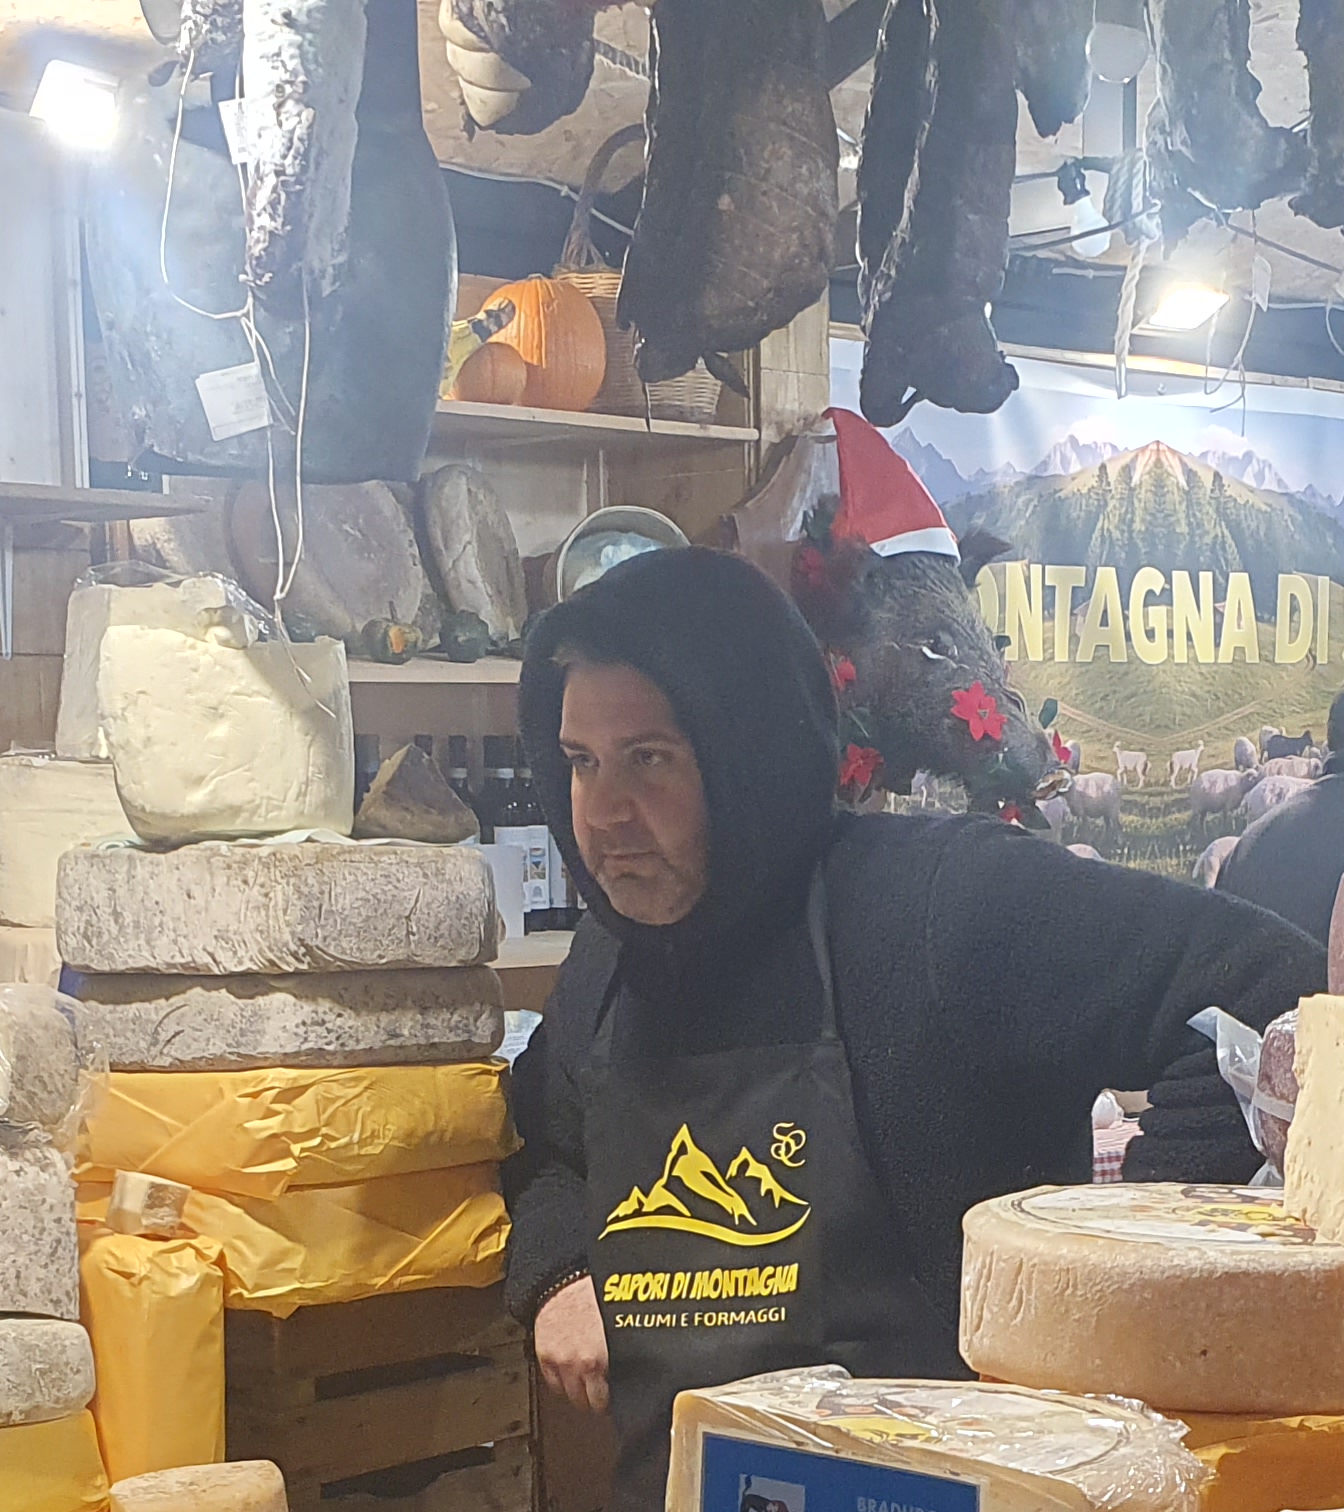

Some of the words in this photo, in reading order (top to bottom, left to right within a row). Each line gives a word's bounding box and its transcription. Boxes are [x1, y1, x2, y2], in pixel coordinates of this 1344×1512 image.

[1273, 573, 1328, 665] DI
[604, 1272, 671, 1302] SAPORI
[671, 1271, 692, 1300] DI
[690, 1262, 800, 1301] MONTAGNA
[614, 1313, 676, 1328] SALUMI
[680, 1312, 690, 1327] E
[694, 1306, 787, 1327] FORMAGGI
